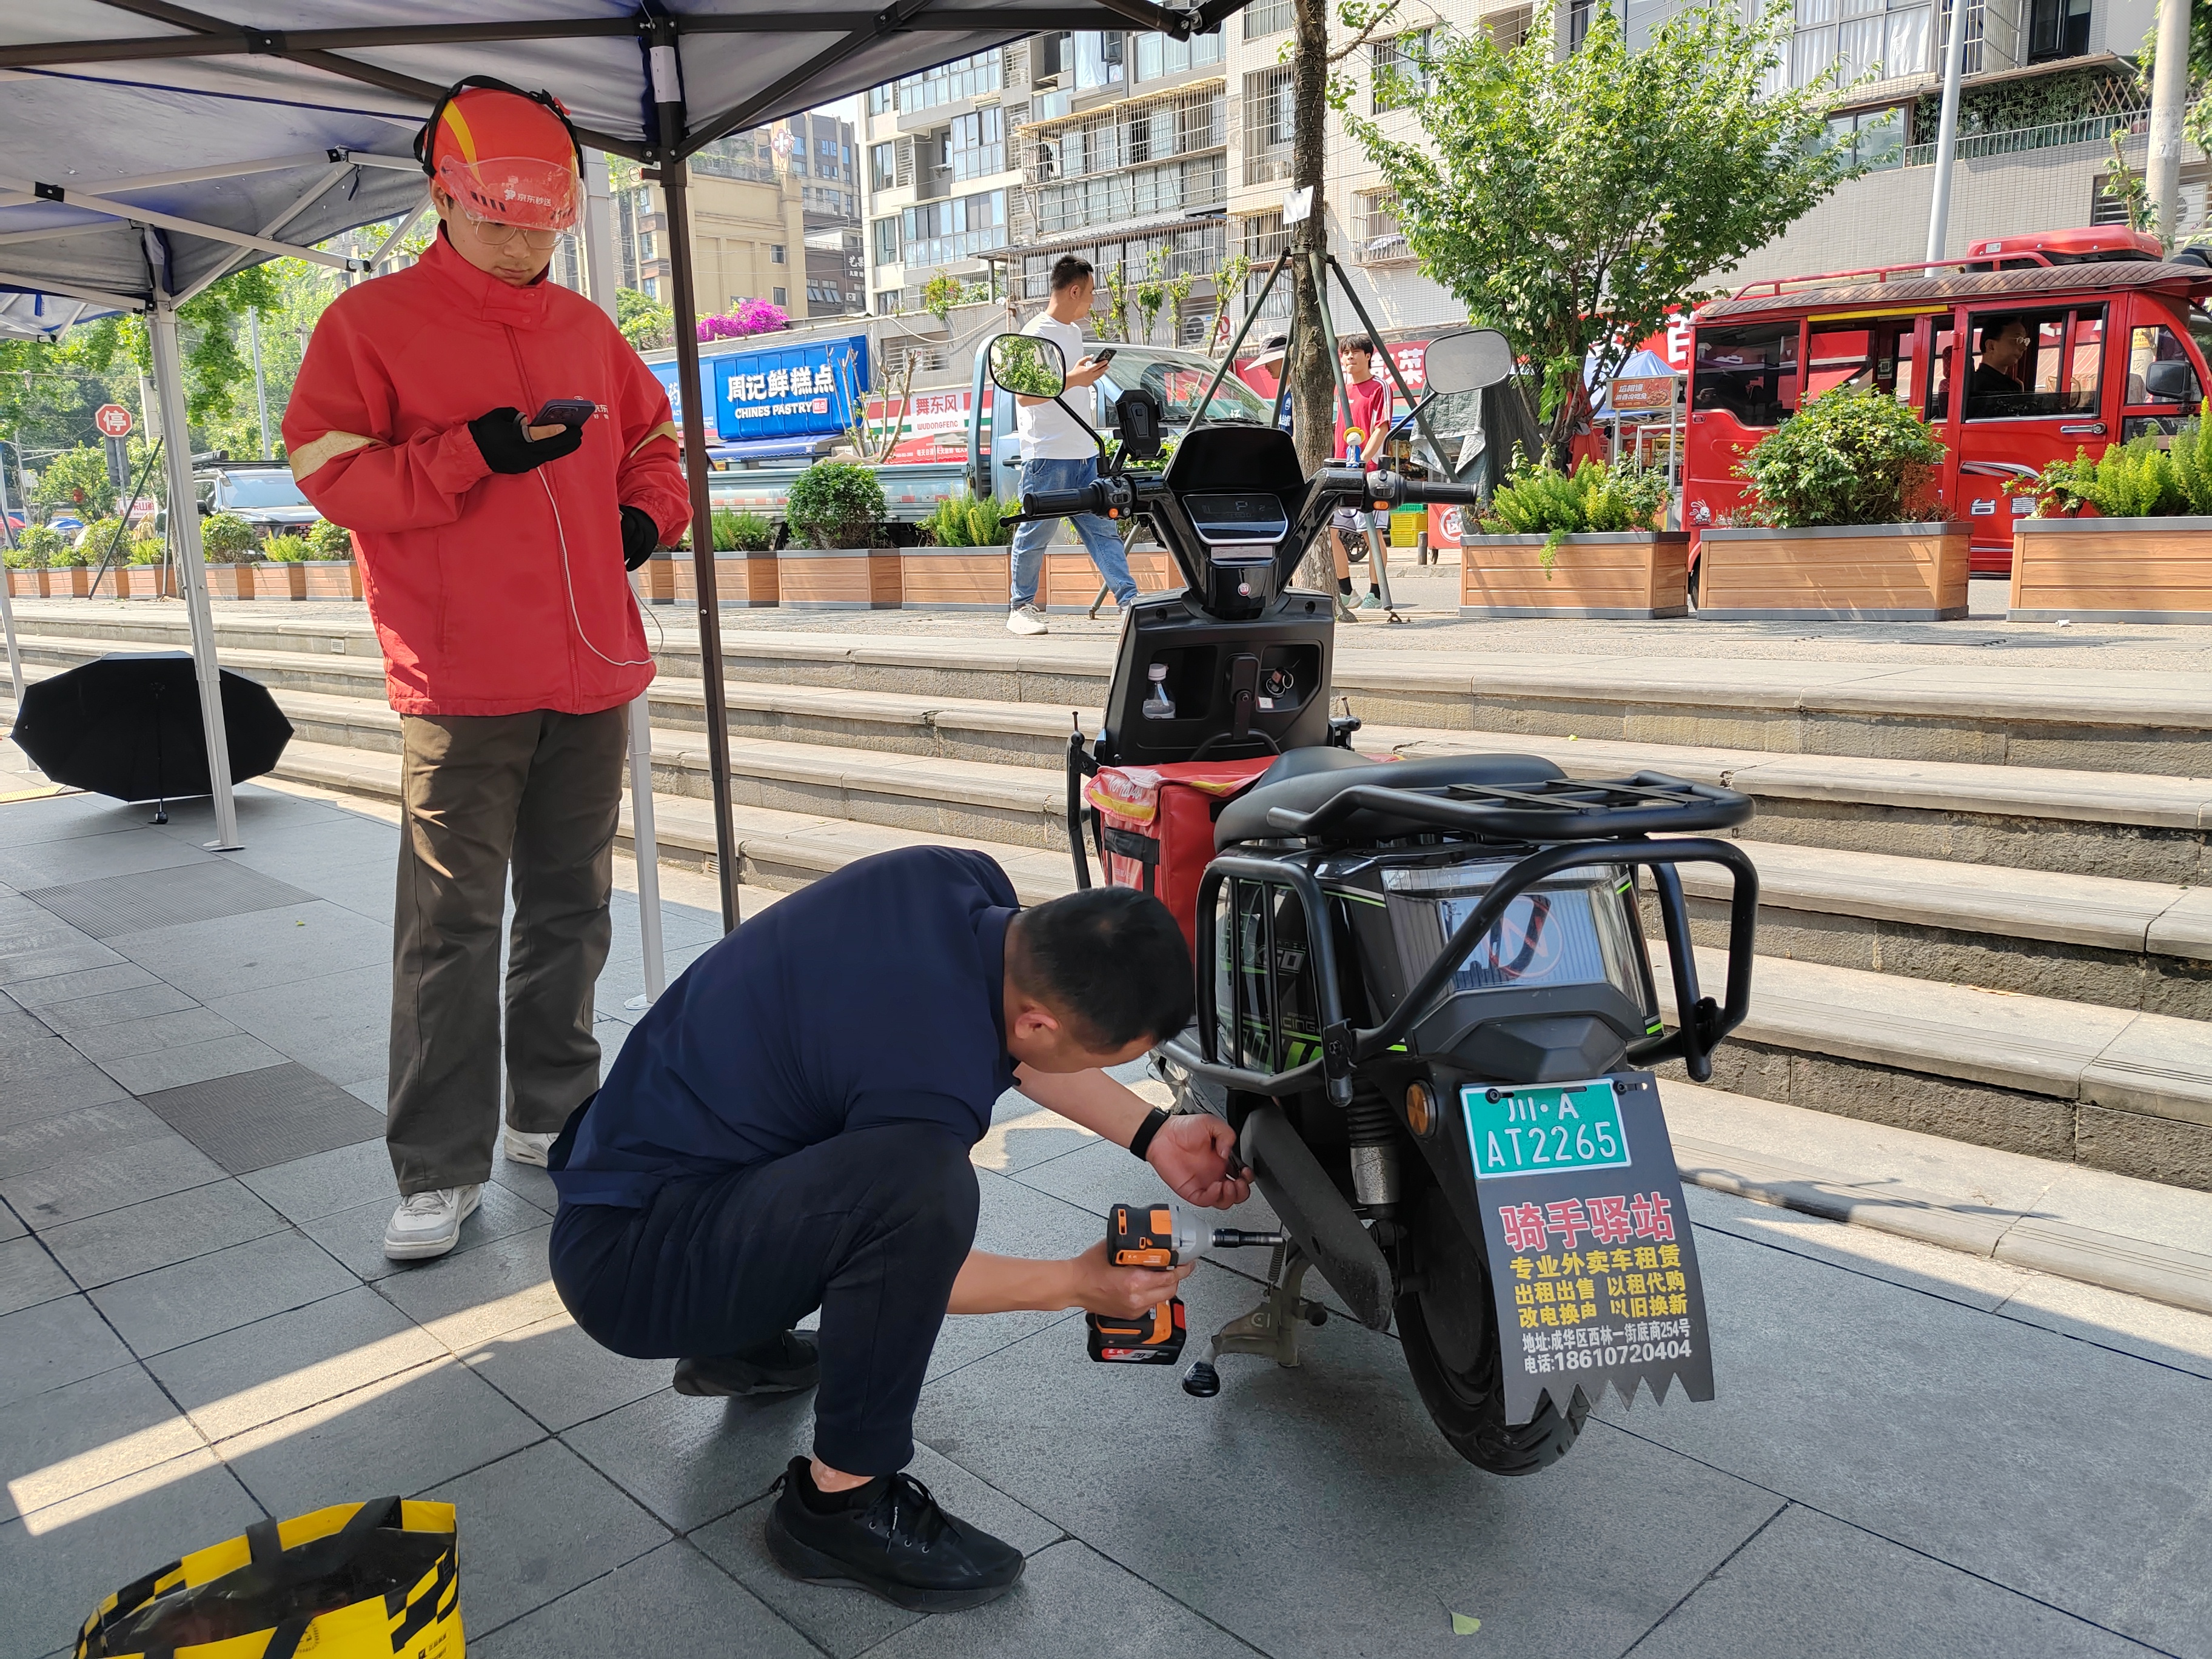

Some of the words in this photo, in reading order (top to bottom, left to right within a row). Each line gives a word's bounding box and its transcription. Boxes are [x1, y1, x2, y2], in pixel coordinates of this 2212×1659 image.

[517, 193, 551, 207] 京东秒送
[668, 382, 681, 406] 药
[727, 364, 835, 403] 周记鲜糕点
[736, 405, 771, 419] CHINES
[773, 401, 813, 415] PASTRY
[916, 394, 958, 417] 舞东风
[103, 409, 127, 432] 停
[1235, 500, 1248, 511] P
[1970, 498, 1997, 515] 台
[1446, 513, 1463, 534] 卤
[1487, 1121, 1616, 1167] AT2265
[1498, 1191, 1676, 1253] 骑手驿站
[1509, 1243, 1681, 1281] 专业外卖车租赁
[1514, 1277, 1595, 1305] 出租出售
[1607, 1269, 1686, 1297] 以租代购
[1610, 1293, 1688, 1319] 以旧换新
[1524, 1339, 1692, 1374] 电话:18610720404
